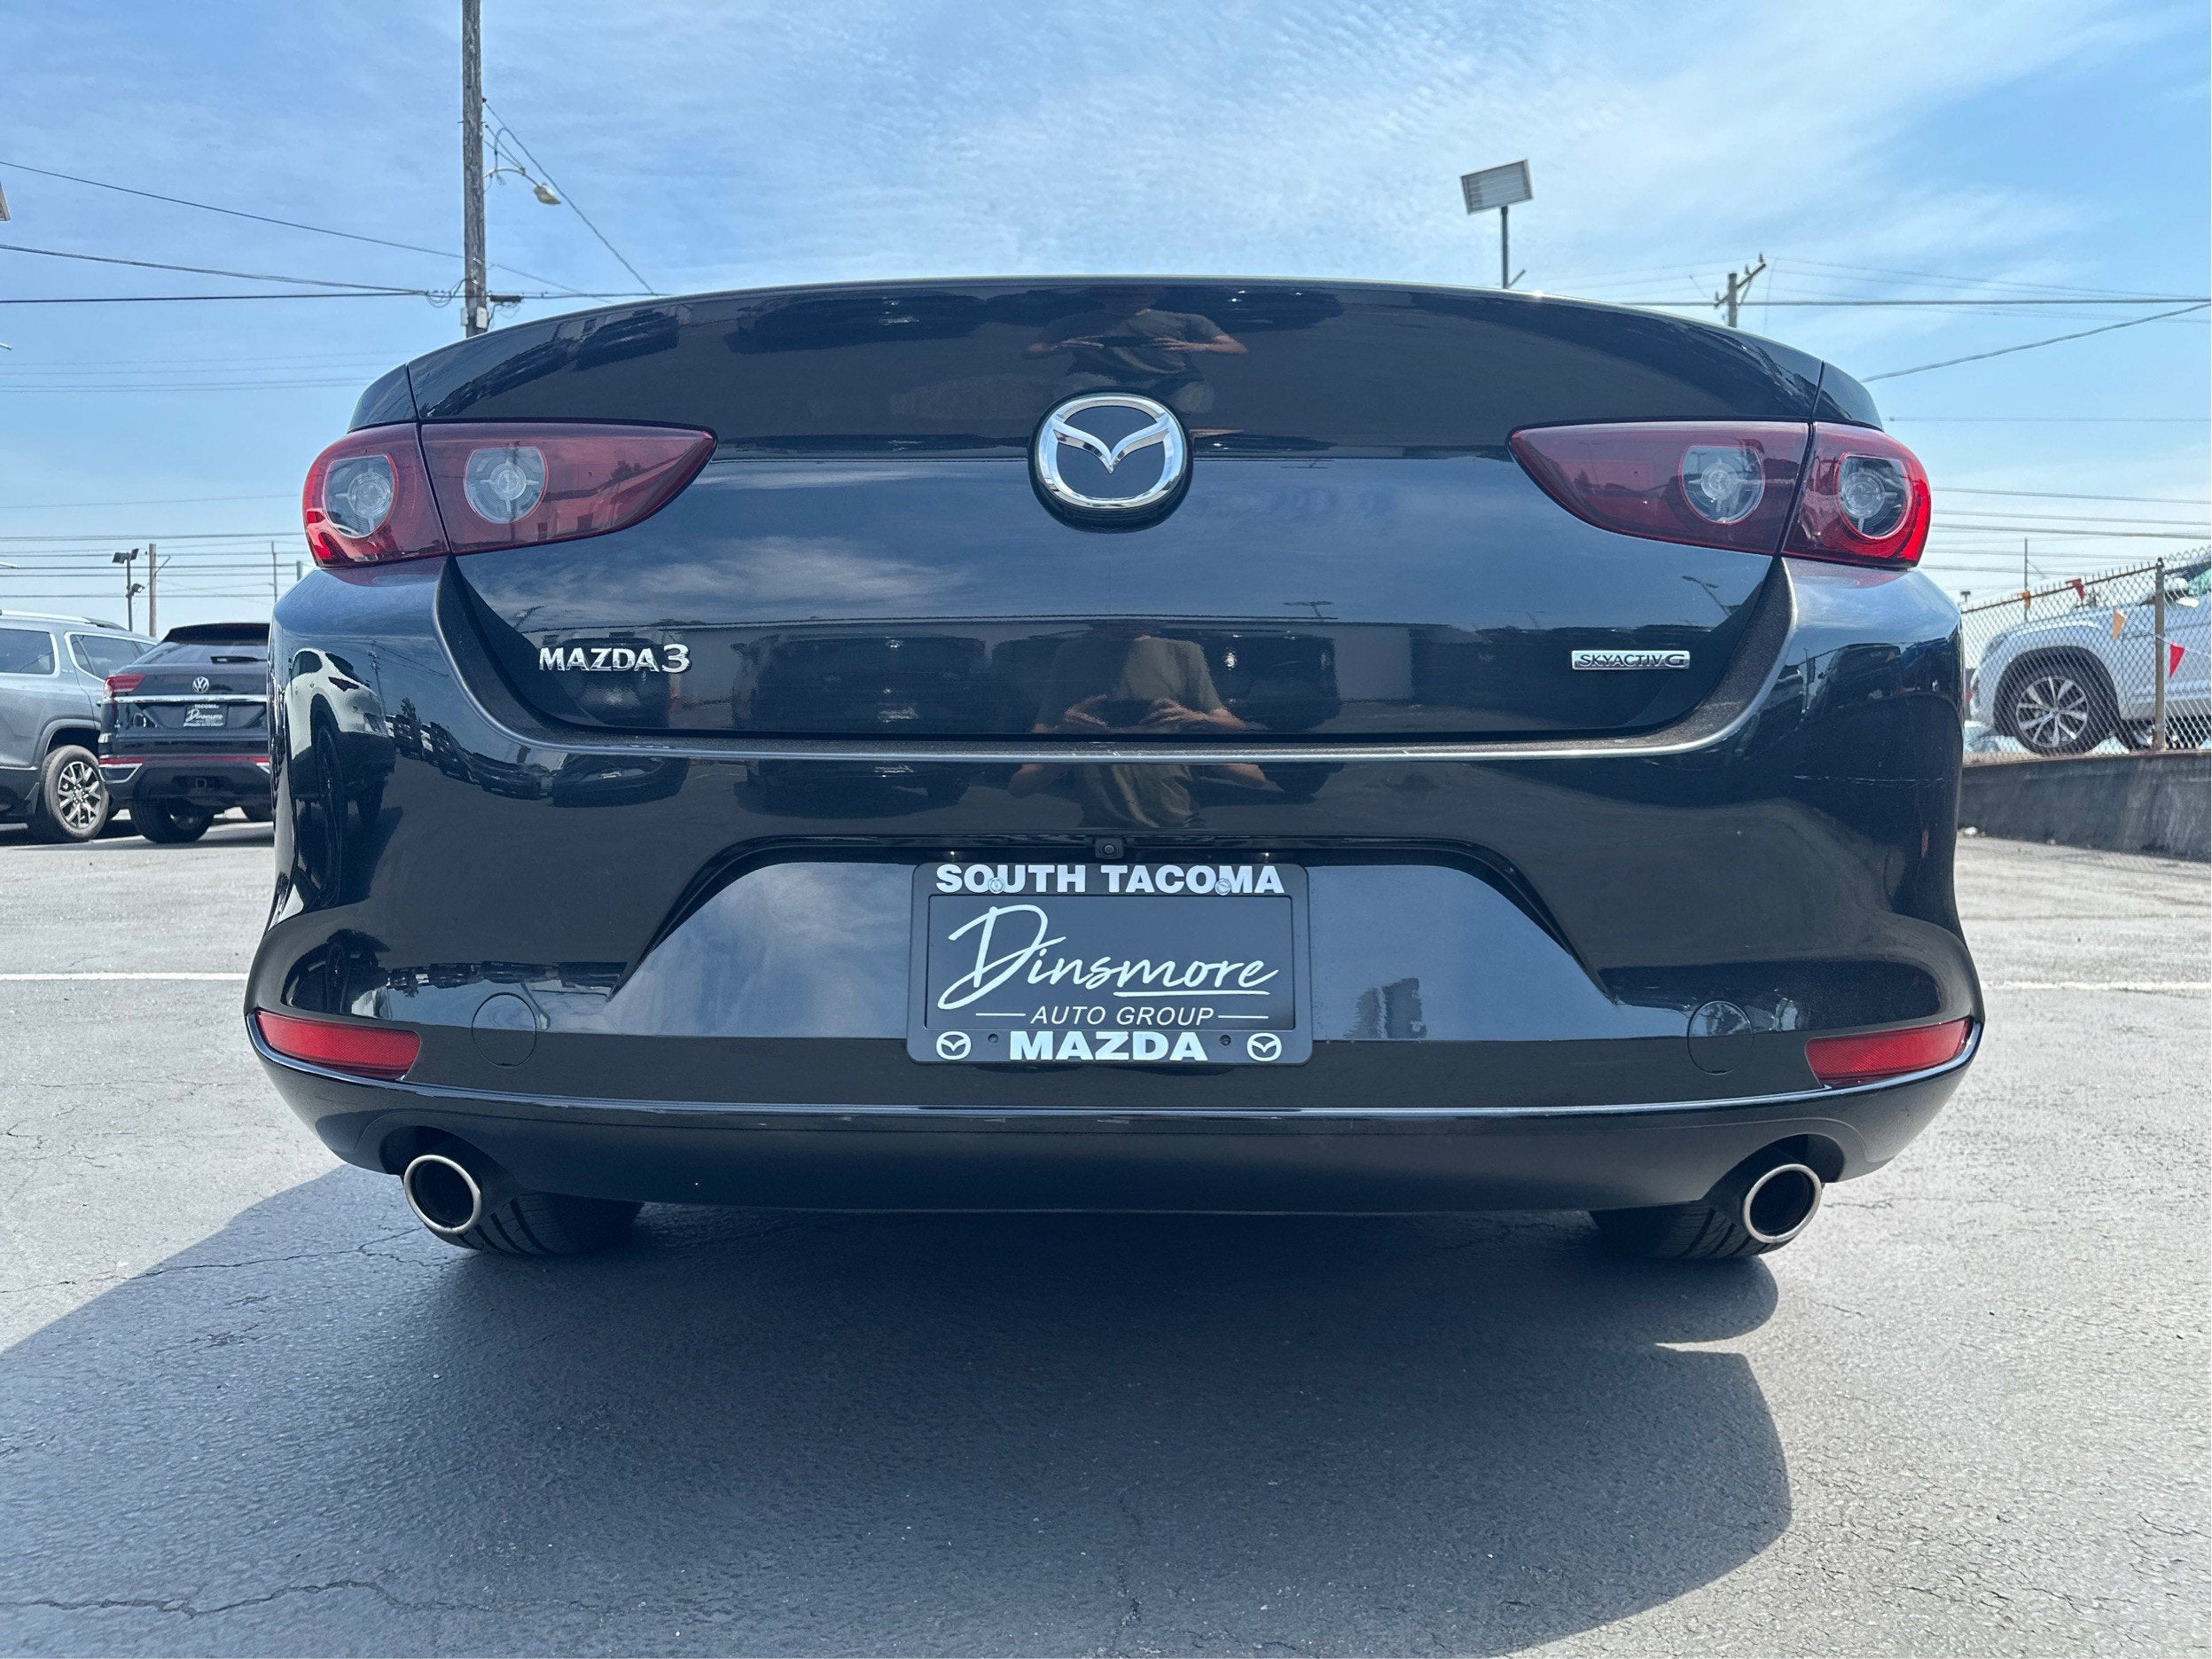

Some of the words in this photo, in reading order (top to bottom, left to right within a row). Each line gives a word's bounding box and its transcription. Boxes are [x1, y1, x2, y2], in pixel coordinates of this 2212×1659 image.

[936, 864, 1086, 893] SOUTH
[1100, 865, 1285, 895] TACOMA
[937, 904, 1278, 1010] Dinsmore
[1030, 1006, 1106, 1025] AUTO
[1116, 1006, 1214, 1026] GROUP
[1010, 1030, 1208, 1061] MAZDA
